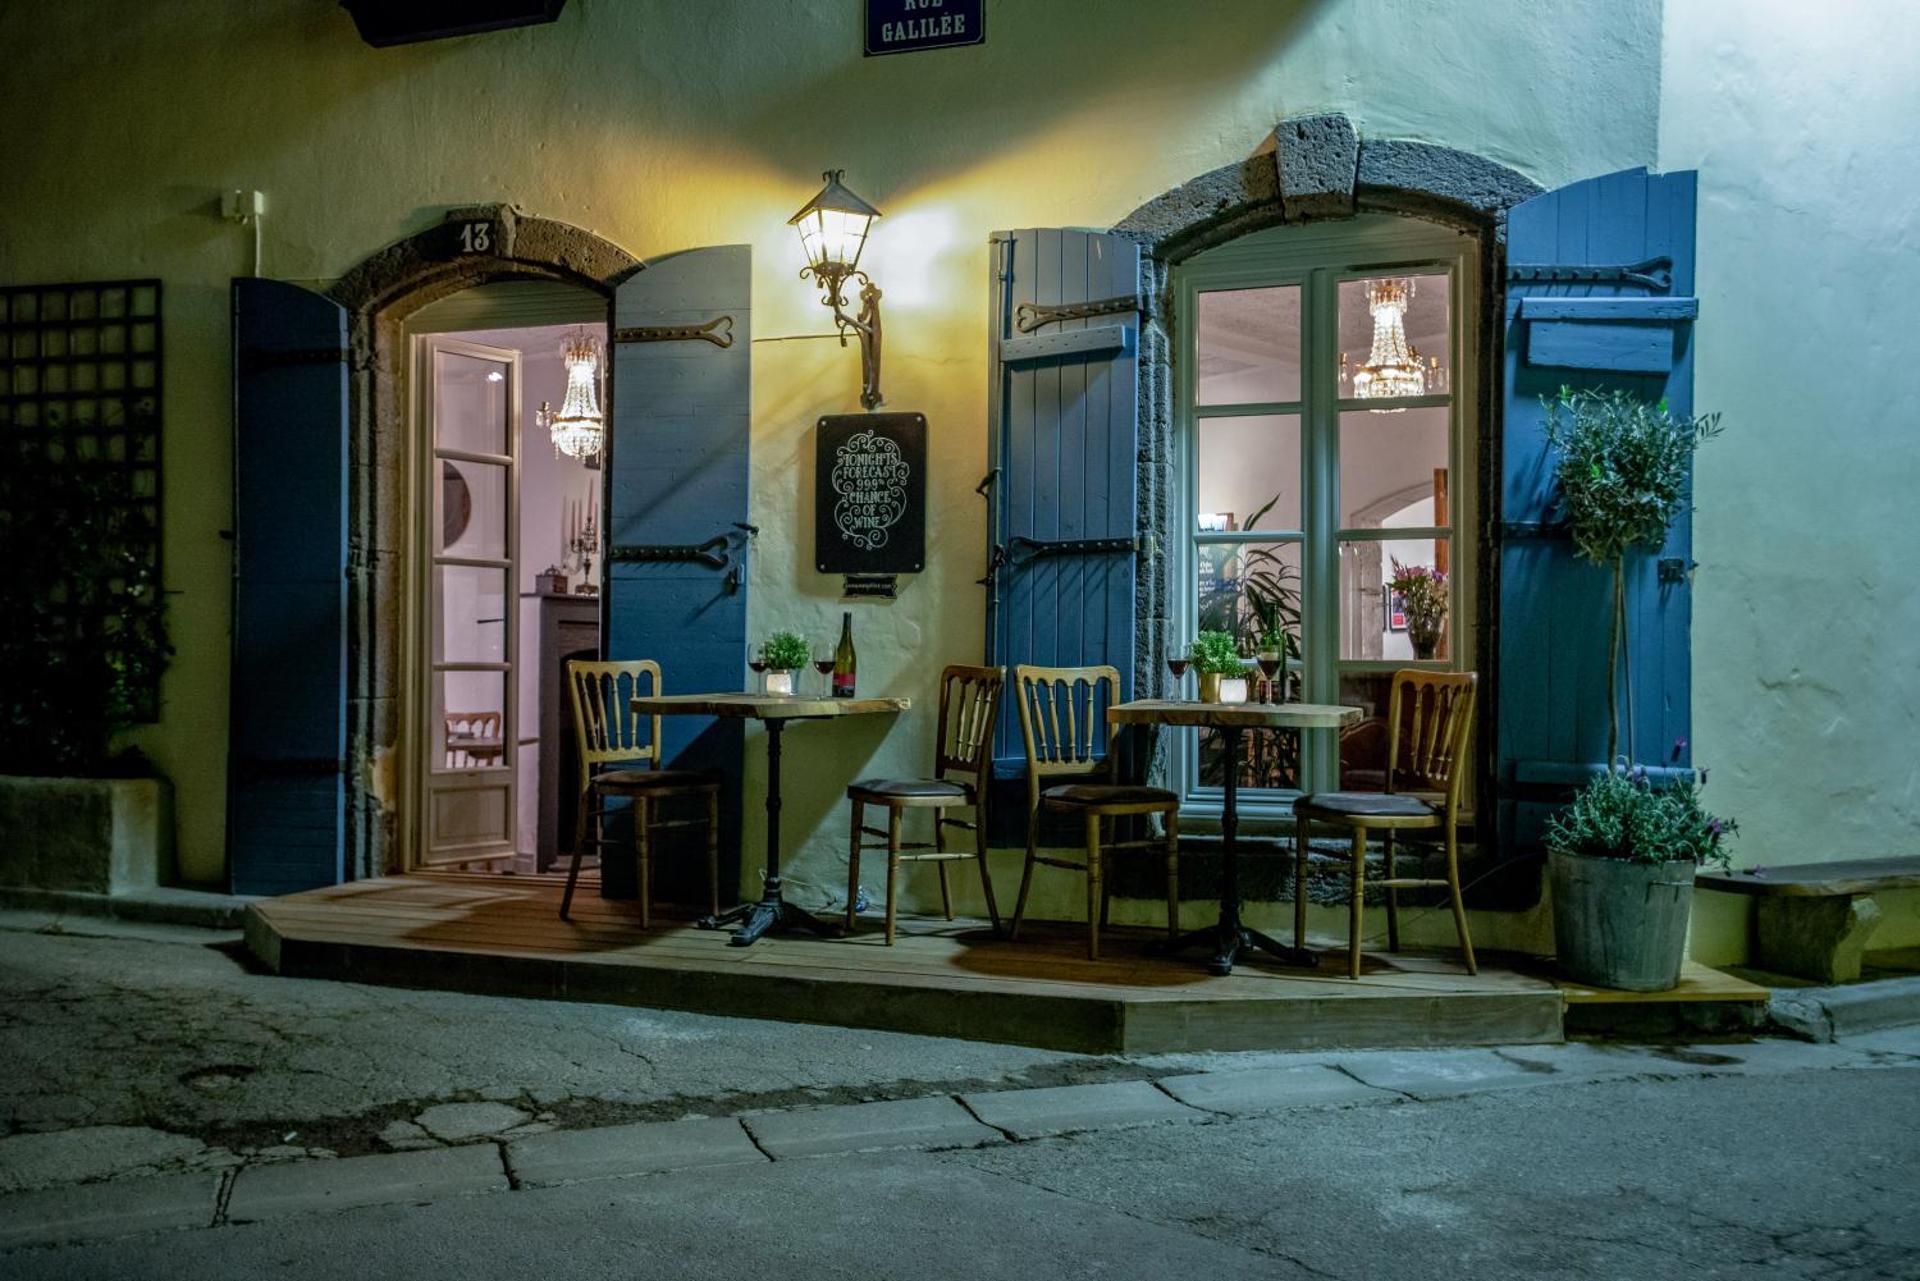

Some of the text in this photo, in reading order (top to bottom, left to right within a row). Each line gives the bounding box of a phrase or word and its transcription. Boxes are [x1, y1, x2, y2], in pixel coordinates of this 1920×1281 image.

[882, 12, 965, 42] GALILÉE
[460, 223, 490, 252] 13
[842, 465, 896, 479] FORECAST
[849, 491, 891, 503] CHANCE
[862, 504, 877, 516] OF
[853, 515, 880, 528] WINE
